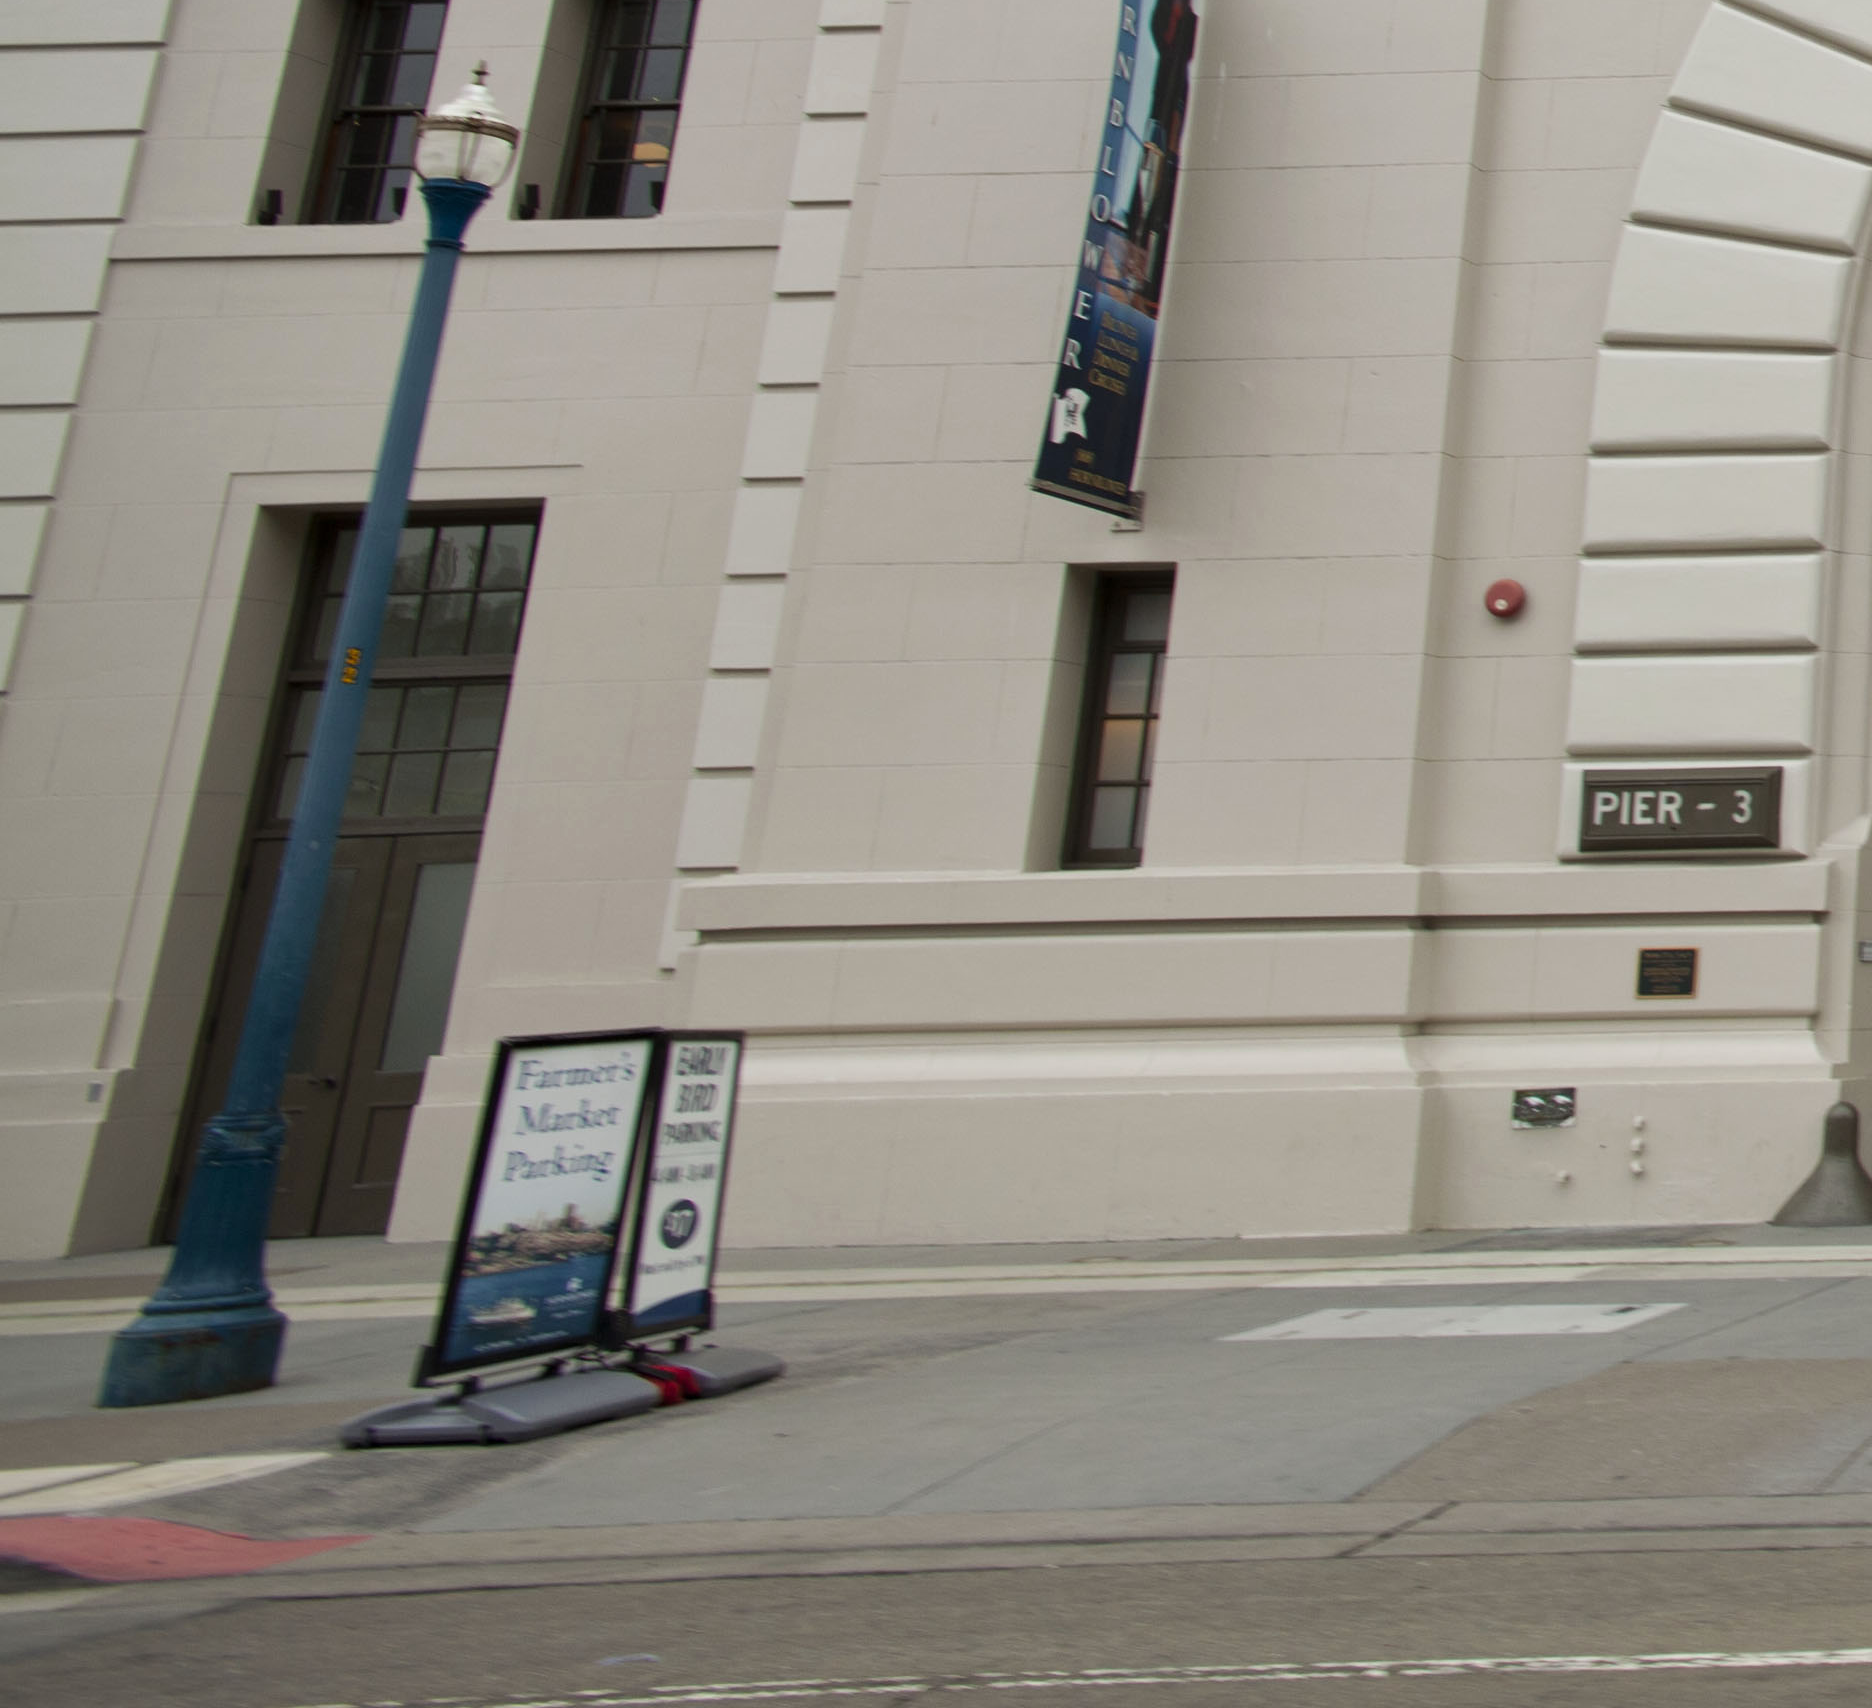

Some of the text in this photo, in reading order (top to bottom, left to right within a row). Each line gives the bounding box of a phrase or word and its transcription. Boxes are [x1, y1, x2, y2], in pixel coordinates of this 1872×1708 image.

[1592, 790, 1684, 826] PIER
[1731, 789, 1753, 824] 3
[516, 1051, 637, 1090] Farmer's
[514, 1099, 622, 1135] Market
[503, 1144, 615, 1182] Parking
